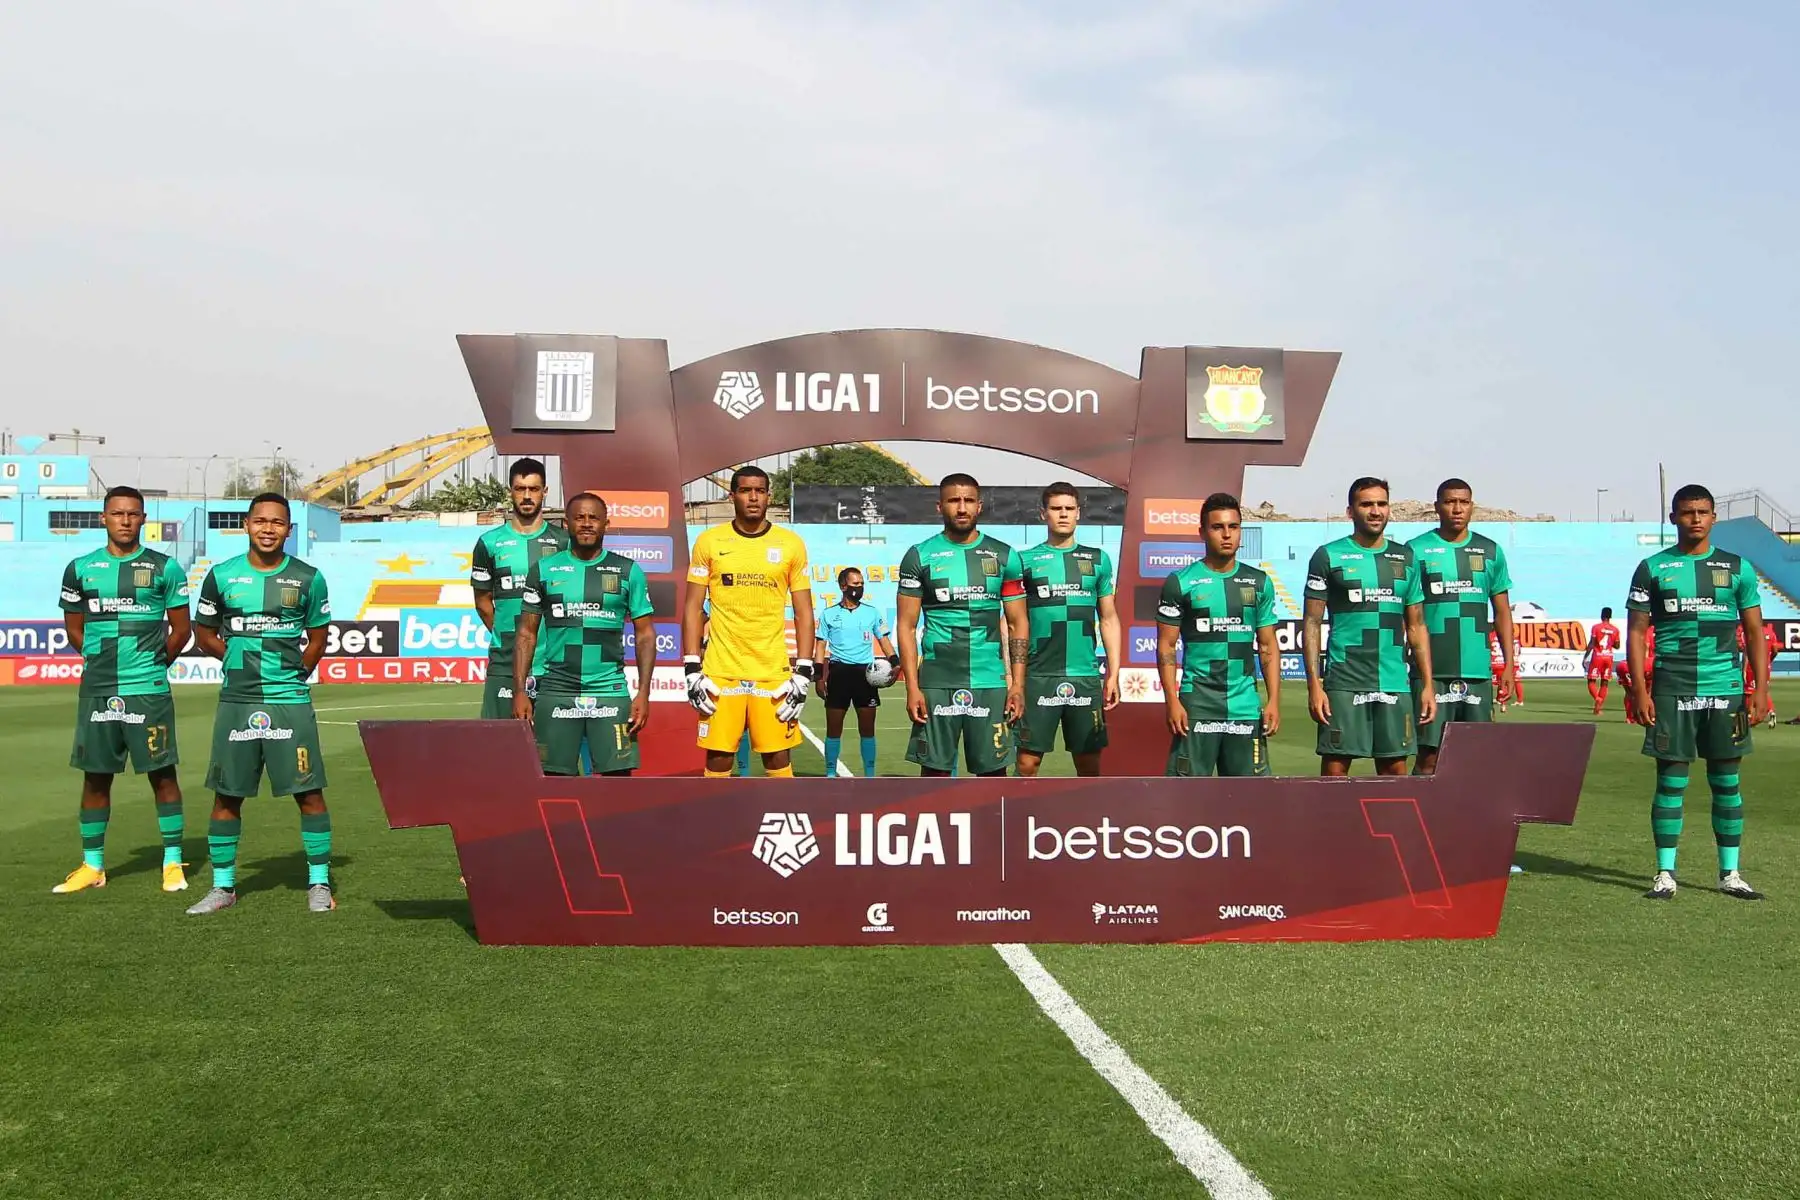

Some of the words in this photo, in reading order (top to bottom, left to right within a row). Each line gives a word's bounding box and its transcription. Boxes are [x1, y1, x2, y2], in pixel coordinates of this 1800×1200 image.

[926, 377, 1100, 415] betsson
[7, 463, 16, 477] 0
[43, 464, 52, 478] 0
[606, 503, 665, 518] tsson
[1148, 509, 1201, 525] betss
[1149, 554, 1203, 567] marath
[736, 580, 778, 588] PICHINCHA
[102, 597, 134, 605] BANCO
[1681, 597, 1714, 605] BANCO
[1681, 604, 1729, 612] PICHINCHA
[566, 610, 617, 619] PICHINCHA
[327, 662, 458, 679] GLORY
[632, 678, 686, 690] Uilabs
[295, 746, 310, 774] 8
[1027, 815, 1251, 861] betsson
[713, 907, 799, 925] betsson
[956, 908, 1031, 921] marathon
[1108, 904, 1158, 915] LATAM
[1218, 905, 1240, 920] SAN
